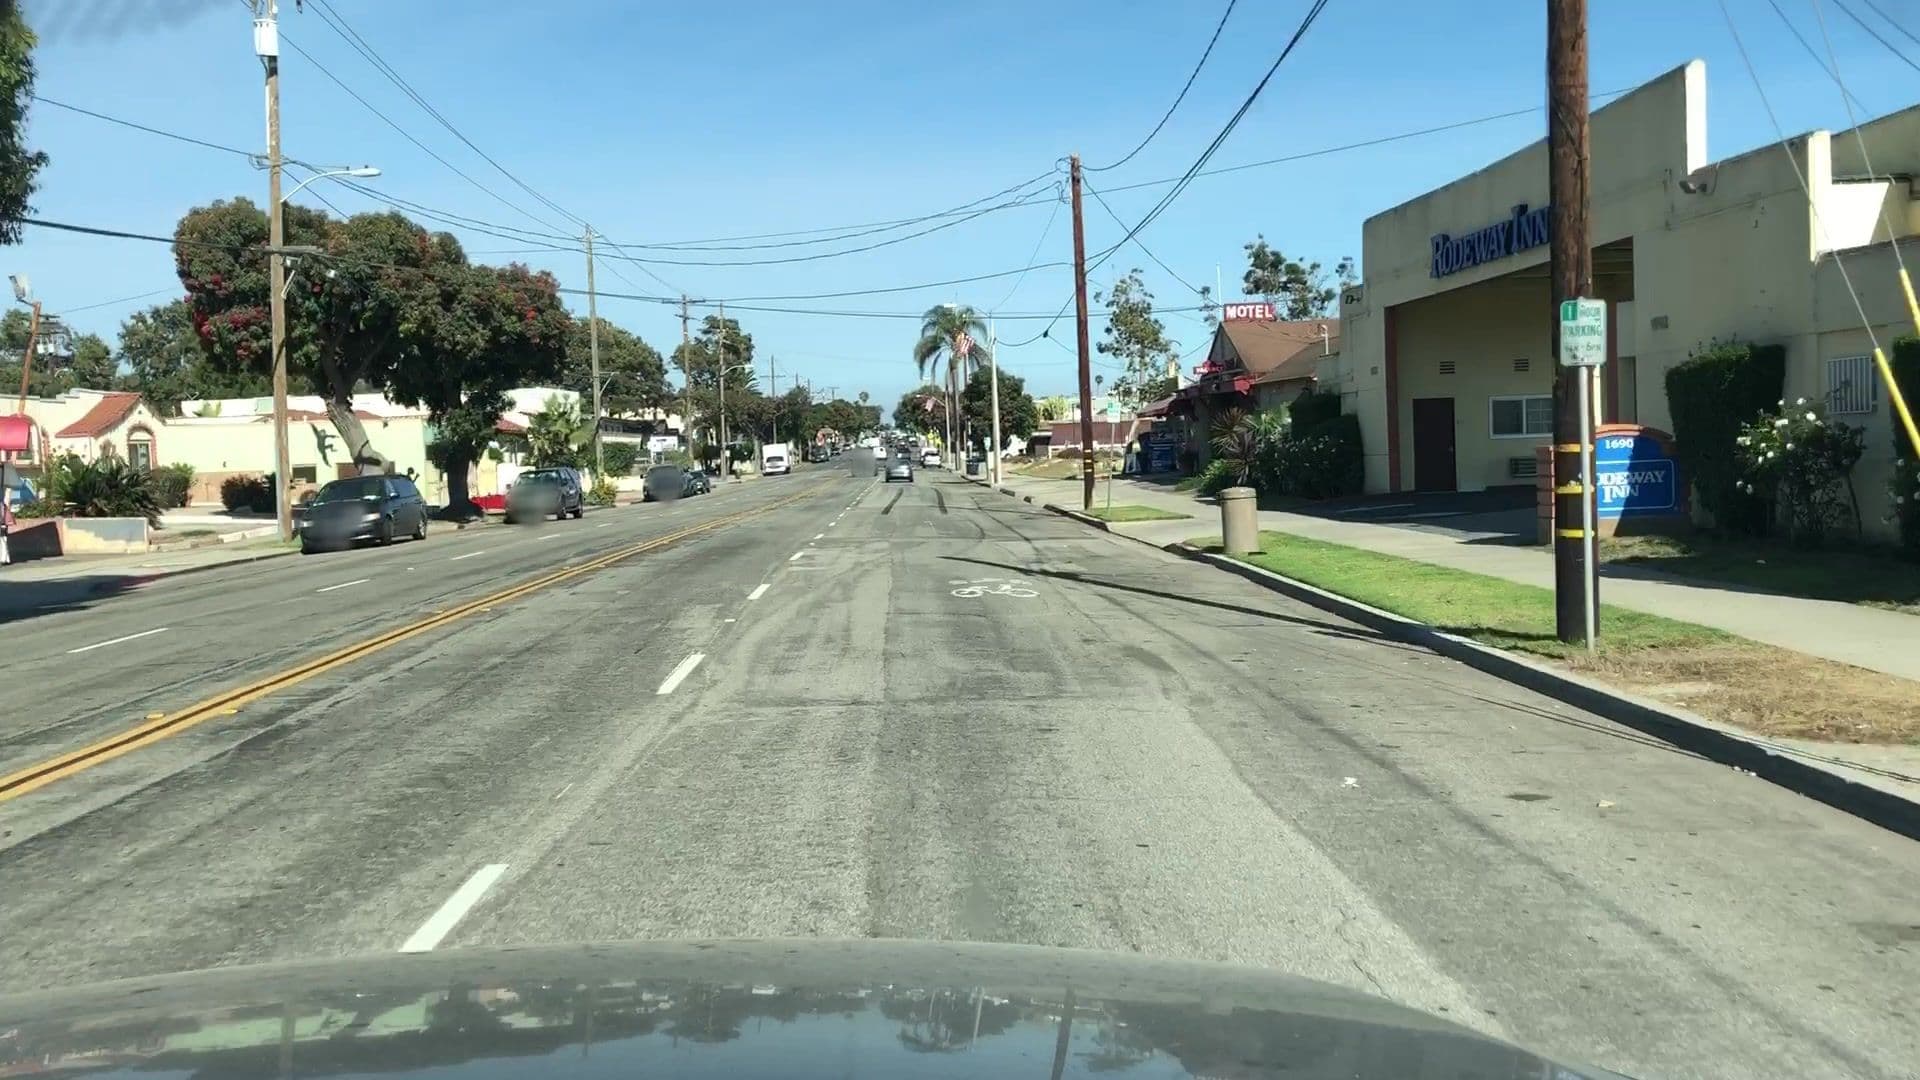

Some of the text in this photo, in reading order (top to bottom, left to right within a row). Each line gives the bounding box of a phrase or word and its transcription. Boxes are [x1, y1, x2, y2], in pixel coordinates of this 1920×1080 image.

[1226, 305, 1273, 319] MOTEL
[1563, 325, 1603, 337] PARKING
[1605, 438, 1634, 449] 1690
[1596, 471, 1666, 486] ODEWAY
[1602, 485, 1639, 503] INN
